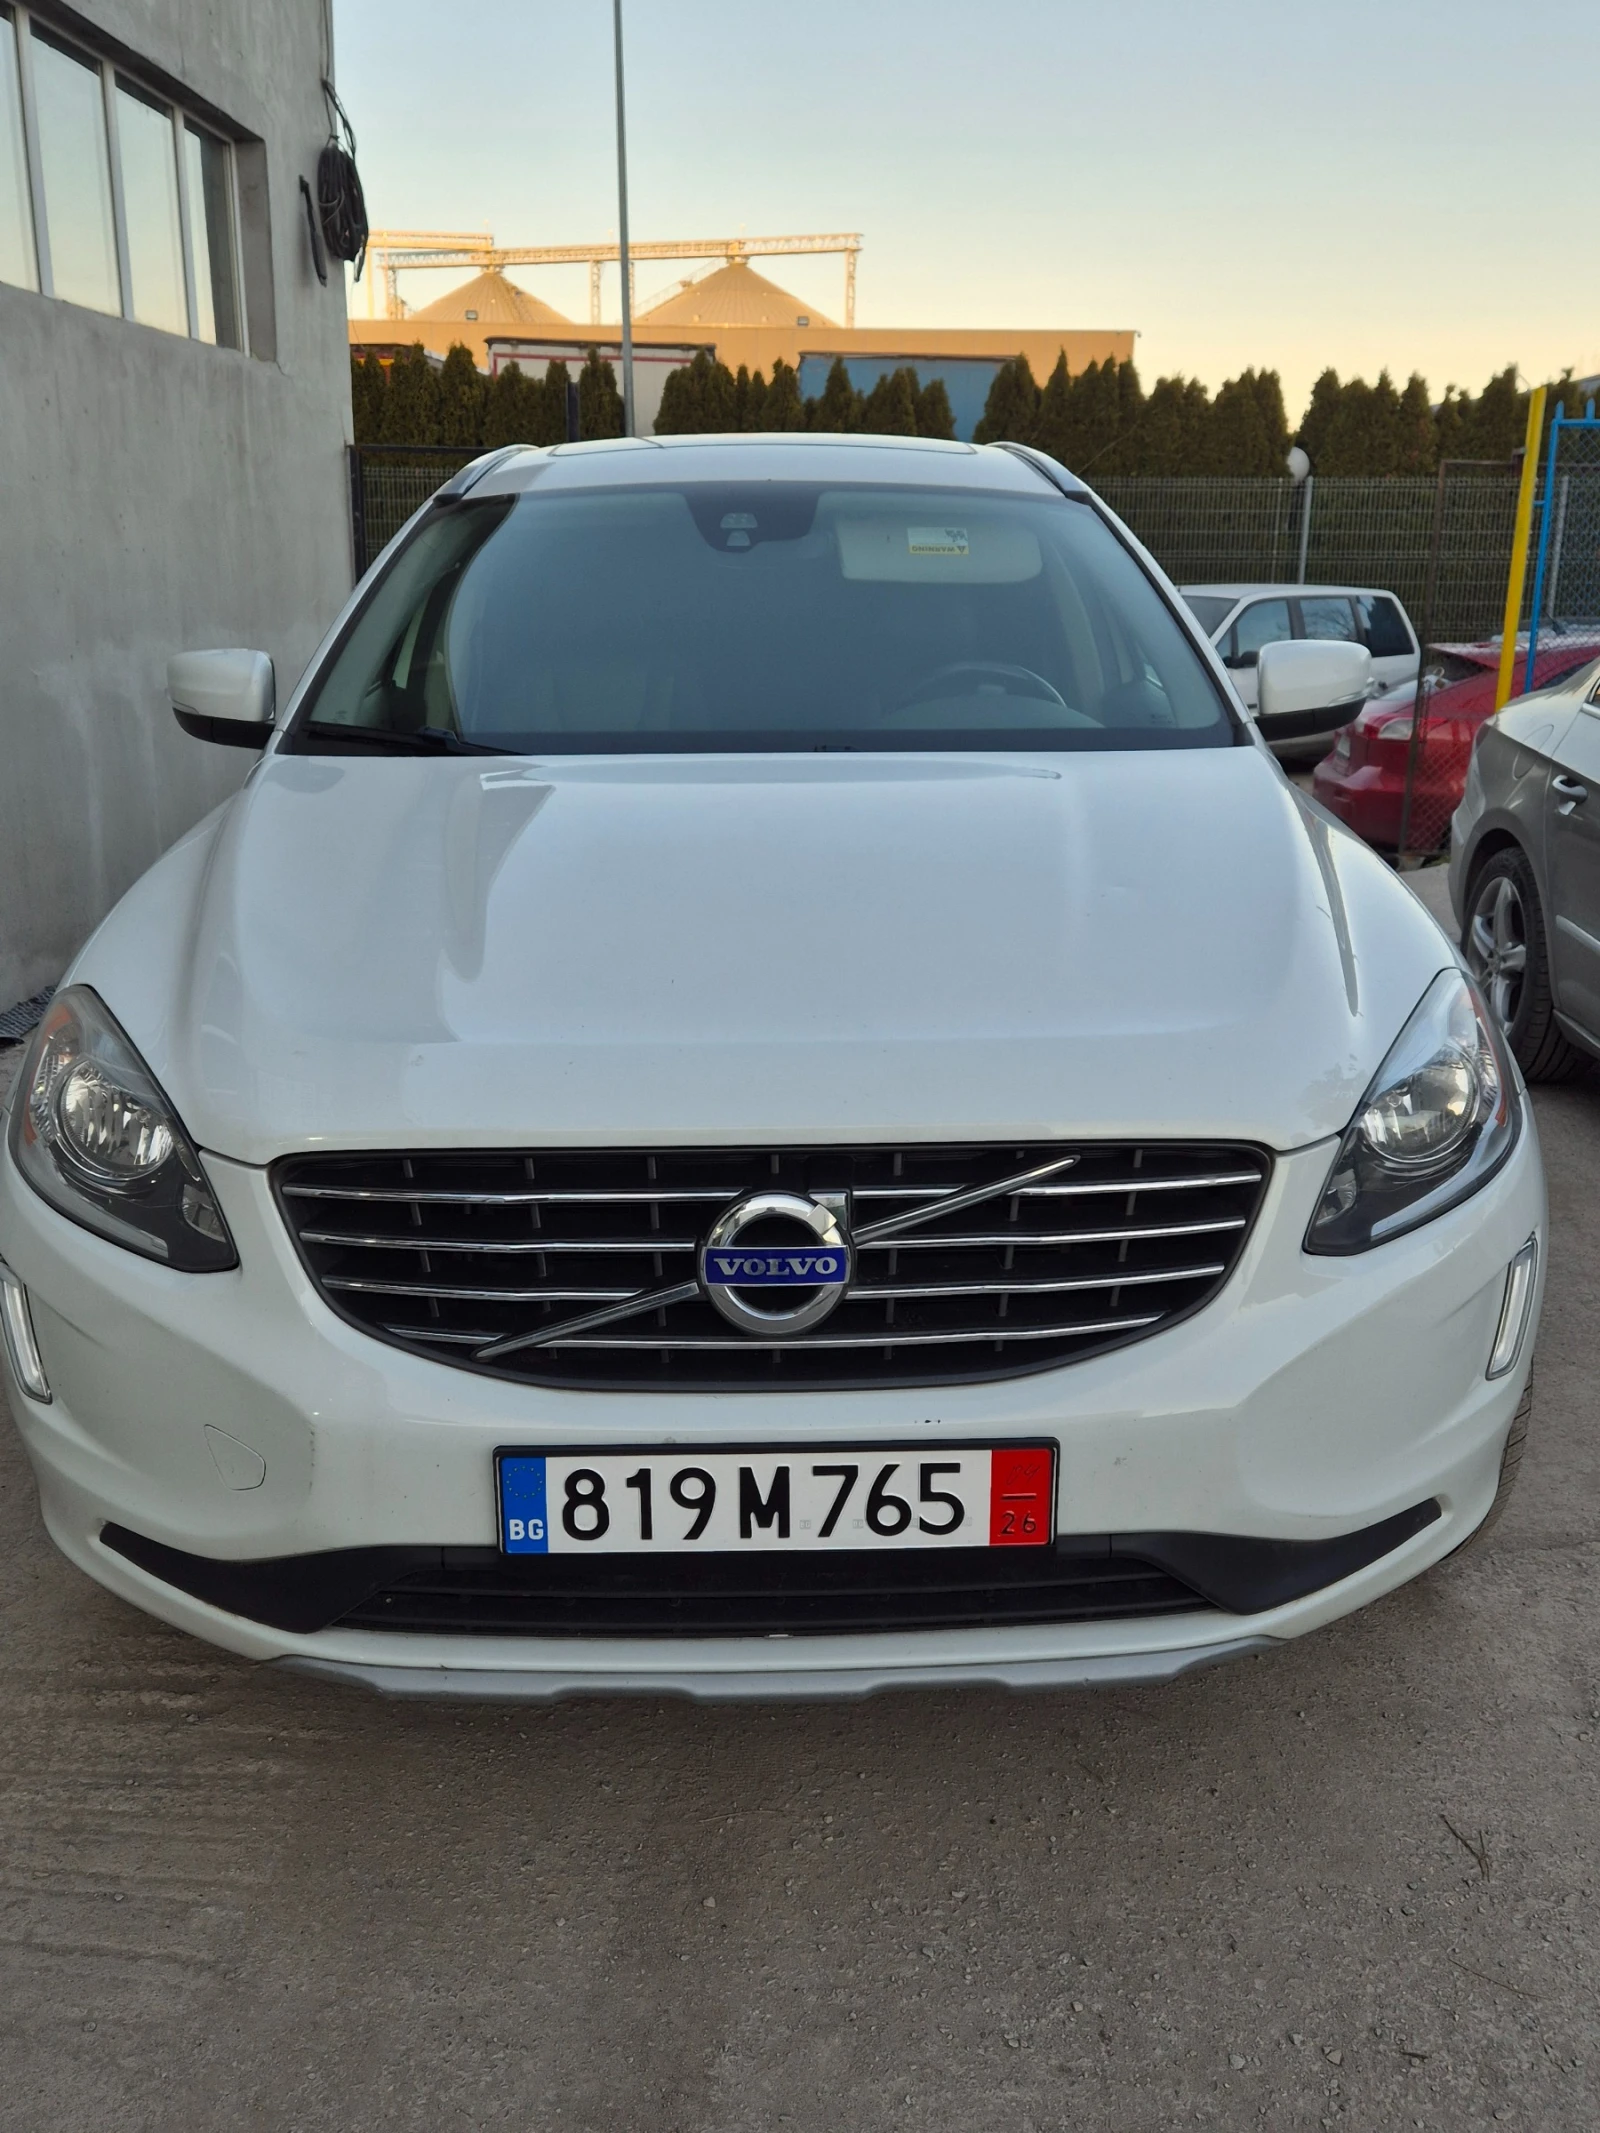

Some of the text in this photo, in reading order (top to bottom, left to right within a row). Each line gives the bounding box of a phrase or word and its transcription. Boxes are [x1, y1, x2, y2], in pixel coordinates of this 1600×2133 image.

[911, 545, 956, 553] WARNING
[713, 1256, 838, 1276] VOLVO
[562, 1462, 965, 1541] 819 M 765
[509, 1518, 544, 1540] BG
[1001, 1510, 1037, 1535] 26
